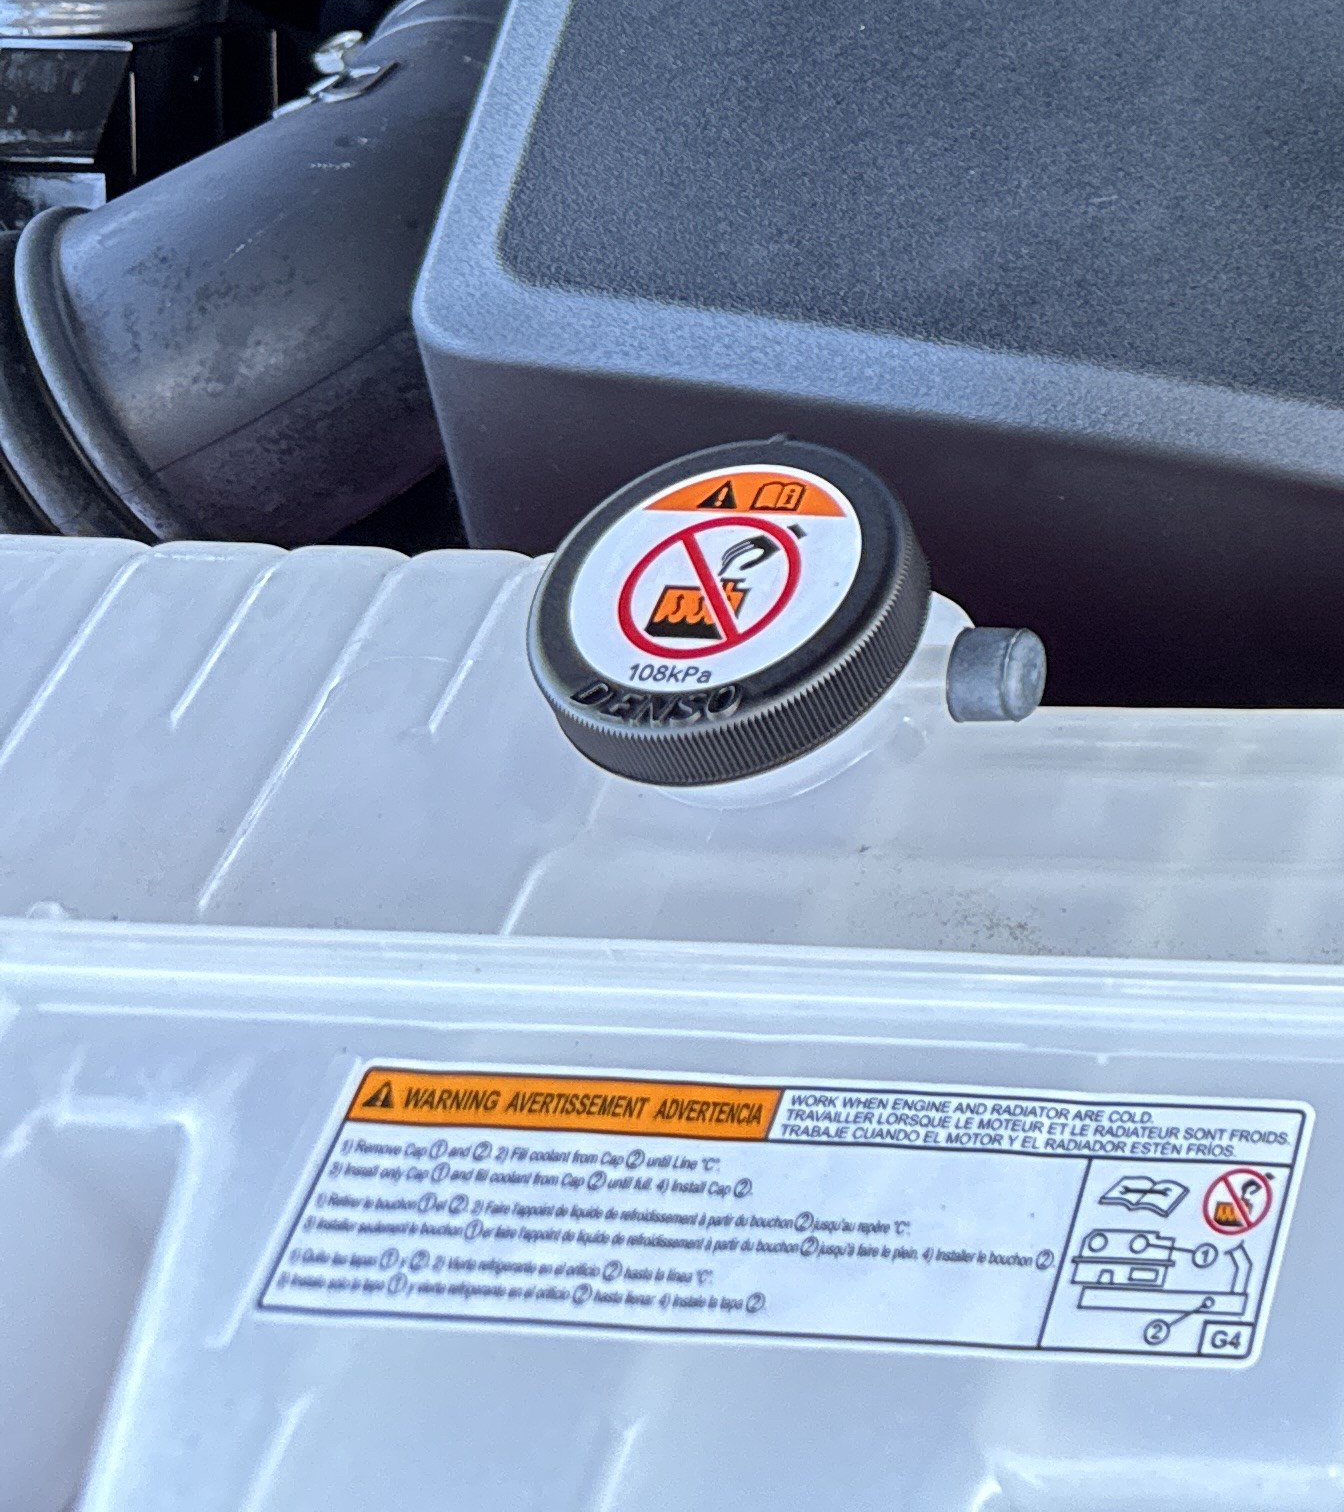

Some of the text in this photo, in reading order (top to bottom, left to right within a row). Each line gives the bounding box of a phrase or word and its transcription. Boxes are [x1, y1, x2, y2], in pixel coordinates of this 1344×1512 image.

[629, 663, 712, 684] 108kPa
[570, 683, 742, 728] DENSO
[403, 1087, 763, 1125] WARNING AVERTISSEMENT ADVERTENCIA
[791, 1094, 1155, 1124] WORK WHEN ENGINE AND RADIATOR ARE COLD.
[781, 1123, 849, 1139] TRABAJE
[851, 1126, 920, 1142] CUANDO
[922, 1130, 940, 1144] EL
[945, 1132, 1004, 1146] MOTOR
[1008, 1134, 1019, 1147] Y
[1020, 1135, 1039, 1150] EL
[1043, 1137, 1127, 1153] RADIADOR
[787, 1108, 1291, 1145] TRAVAILLER LORSQUE LE MOTEUR ET LE RADIATEUR SONT FROIDS.
[599, 1151, 624, 1169] Cap
[671, 1155, 698, 1171] Line
[707, 1180, 731, 1199] Cap
[1210, 1330, 1241, 1349] G4
